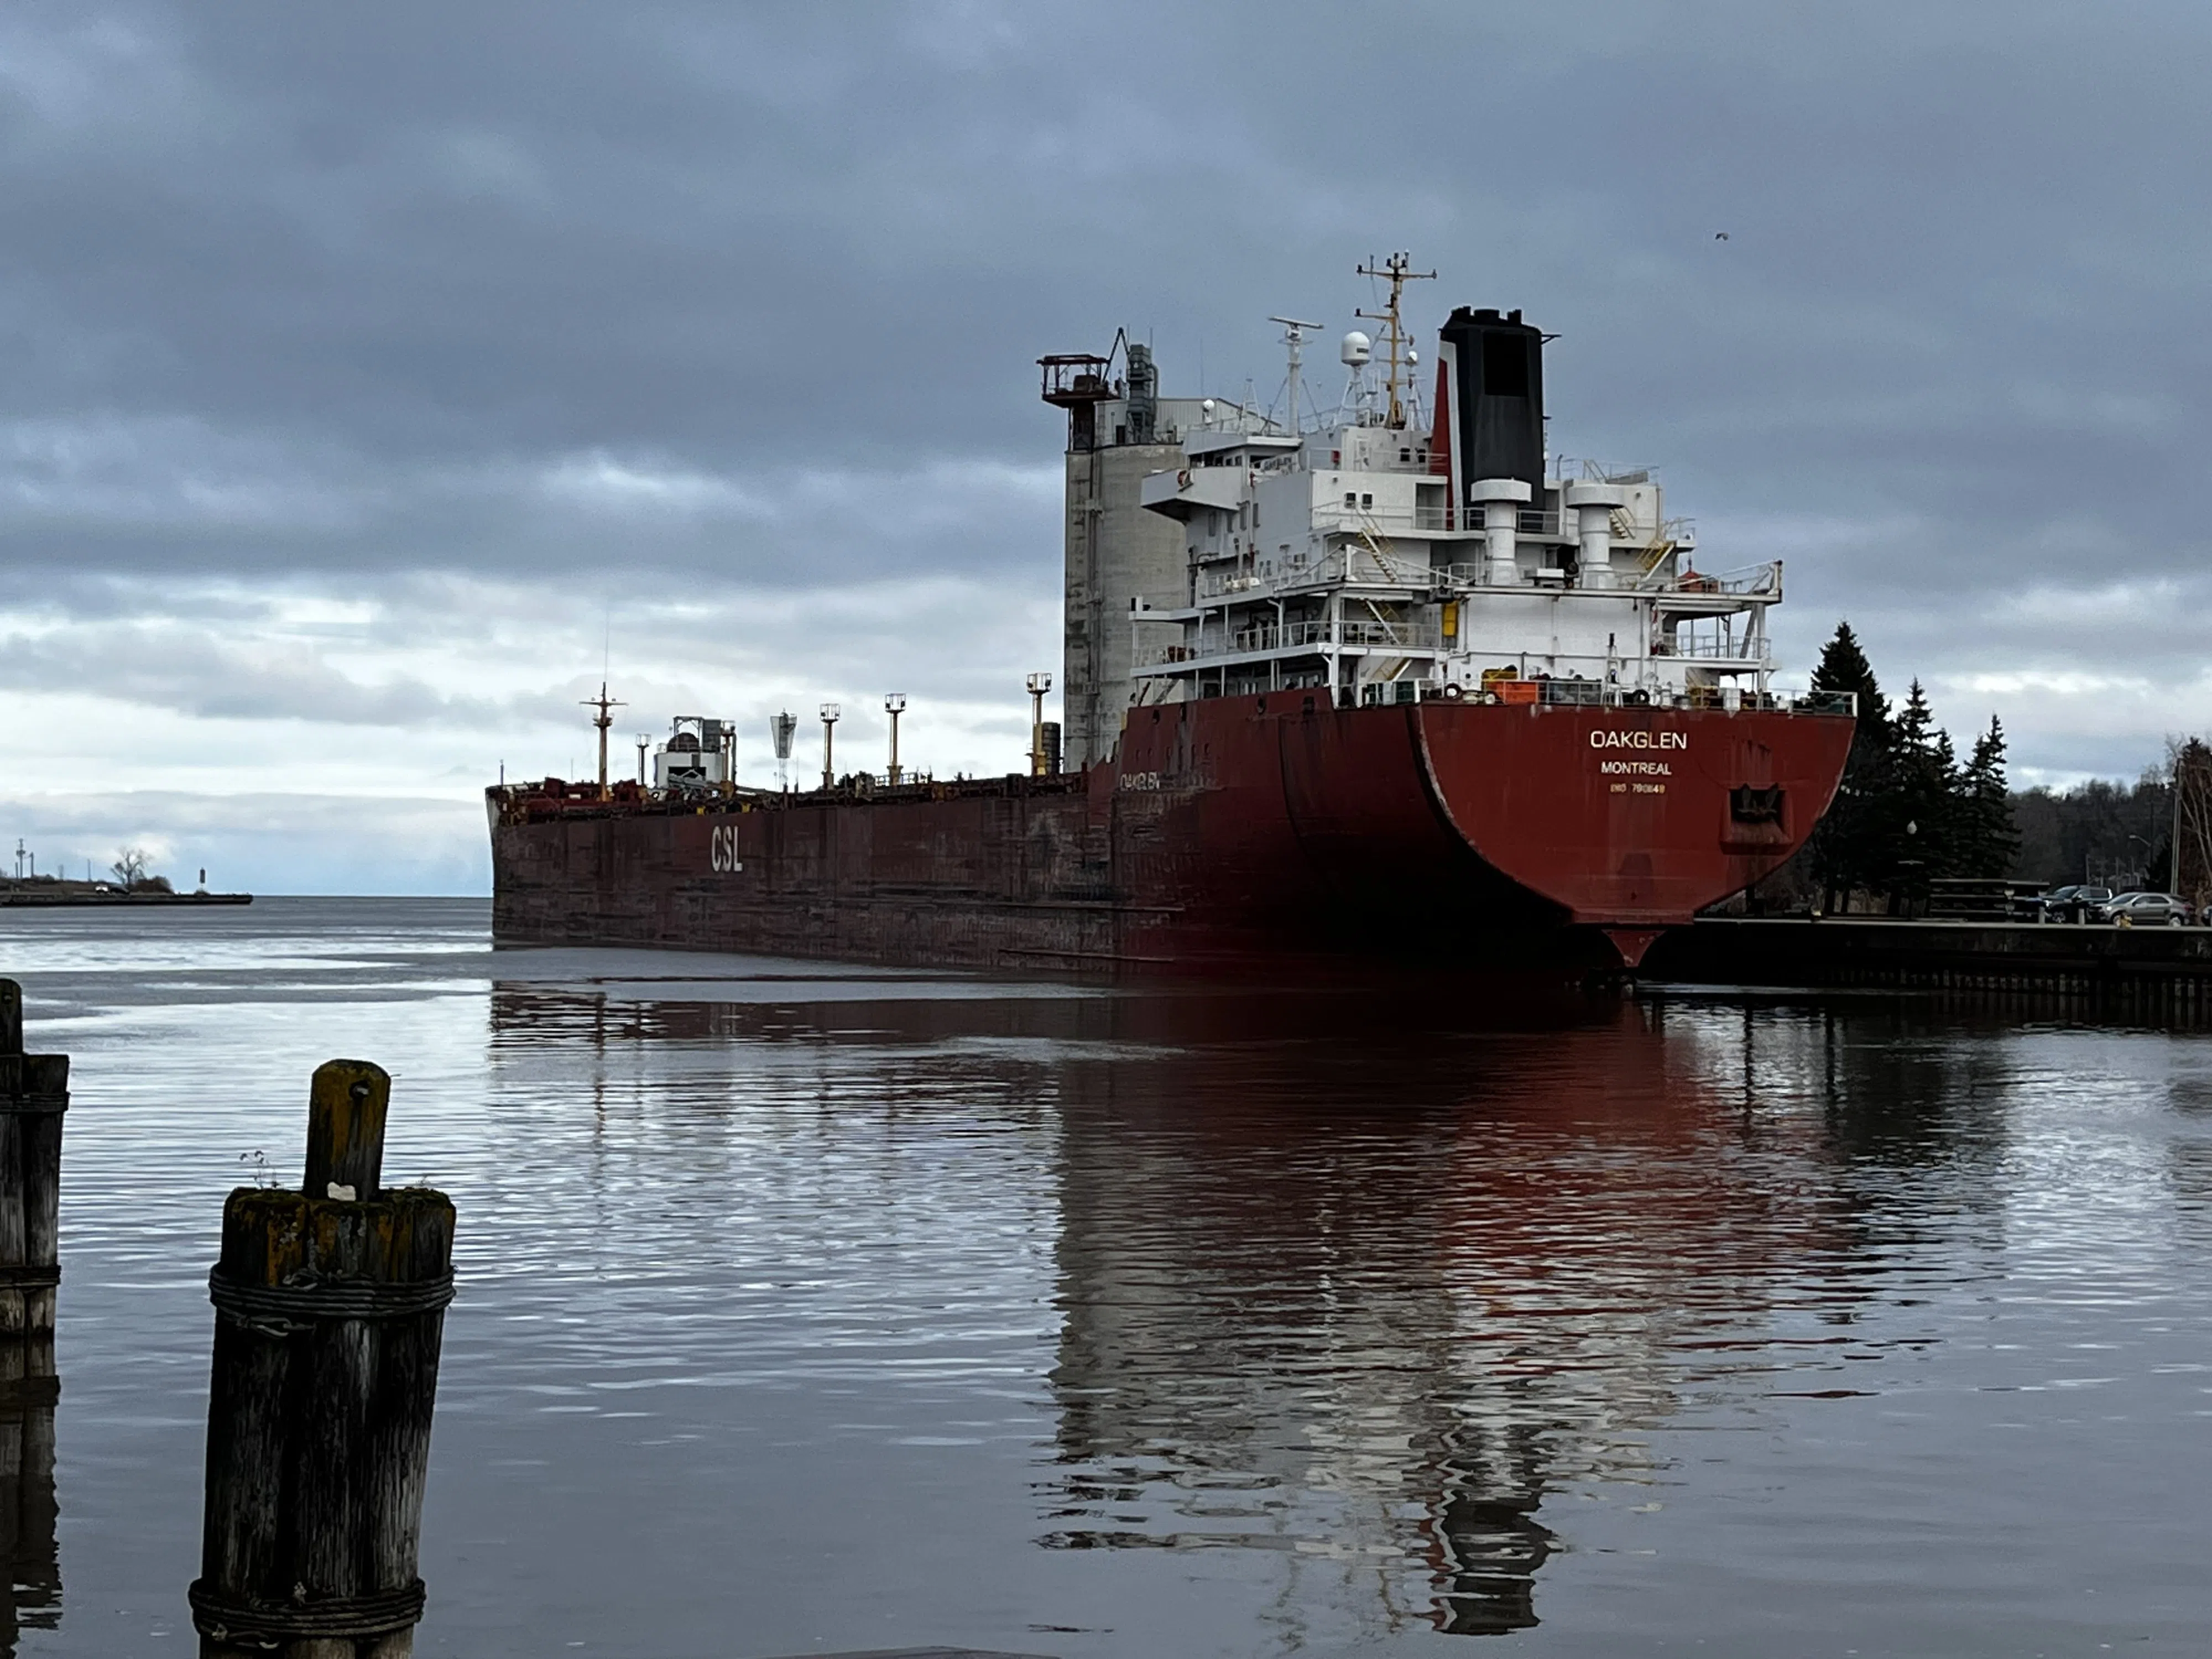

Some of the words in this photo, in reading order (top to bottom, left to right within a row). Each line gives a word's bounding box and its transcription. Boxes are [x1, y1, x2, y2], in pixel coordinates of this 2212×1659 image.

[1590, 730, 1687, 750] OAKGLEN
[1601, 761, 1672, 775] MONTREAL
[711, 825, 743, 872] CSL
